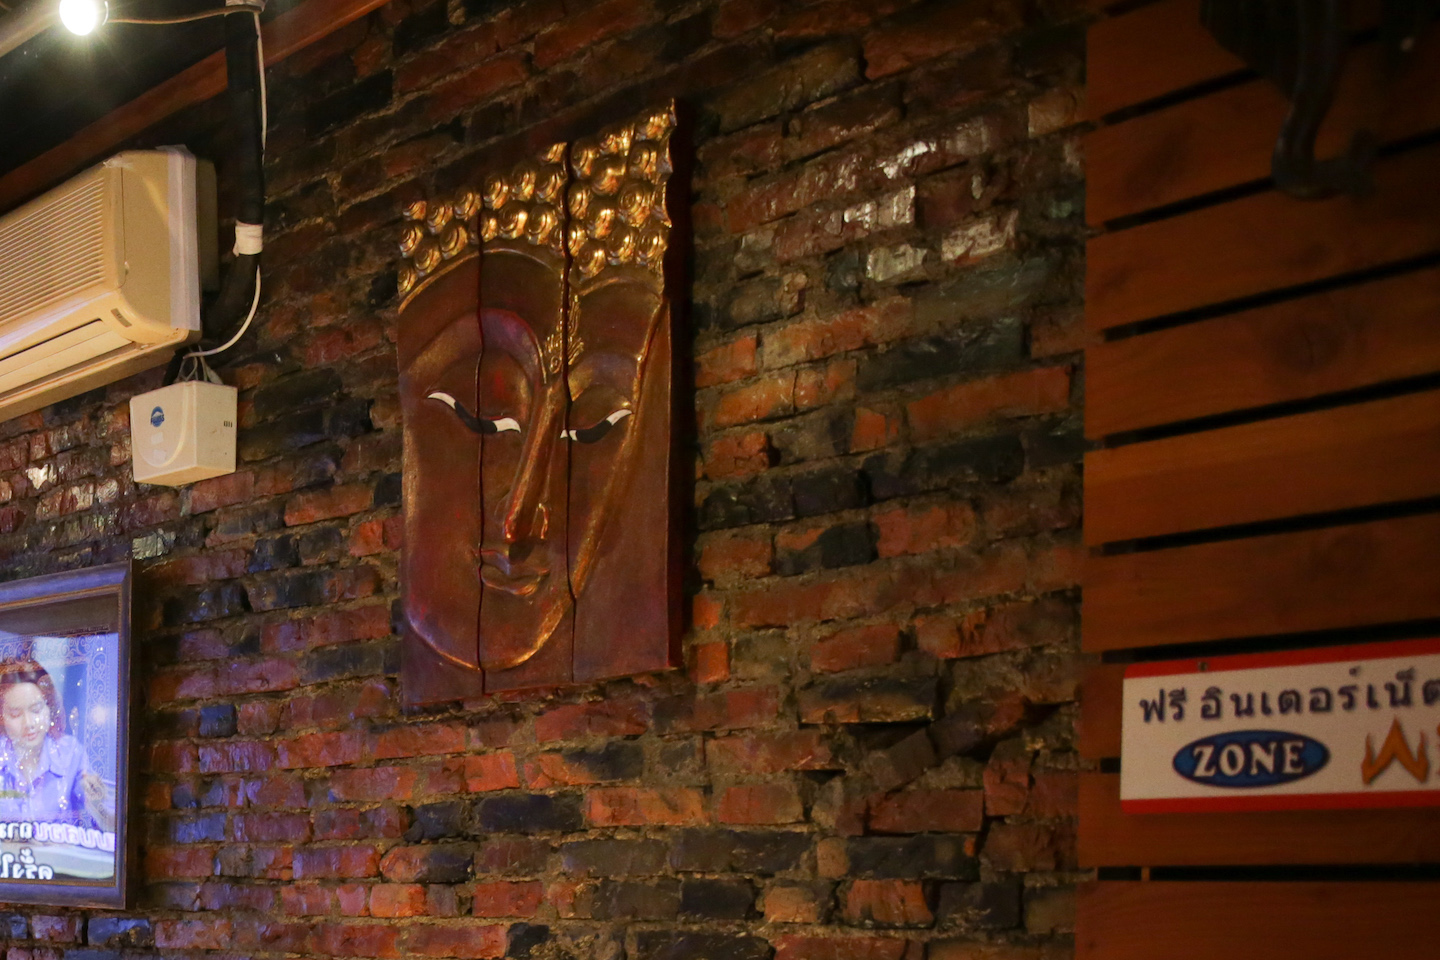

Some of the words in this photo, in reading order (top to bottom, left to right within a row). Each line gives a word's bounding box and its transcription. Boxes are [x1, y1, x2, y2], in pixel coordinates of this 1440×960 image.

[1139, 686, 1188, 724] ฟรี
[1200, 665, 1440, 720] อินเตอร์เน็ต
[1191, 740, 1306, 778] ZONE
[1360, 716, 1440, 785] W
